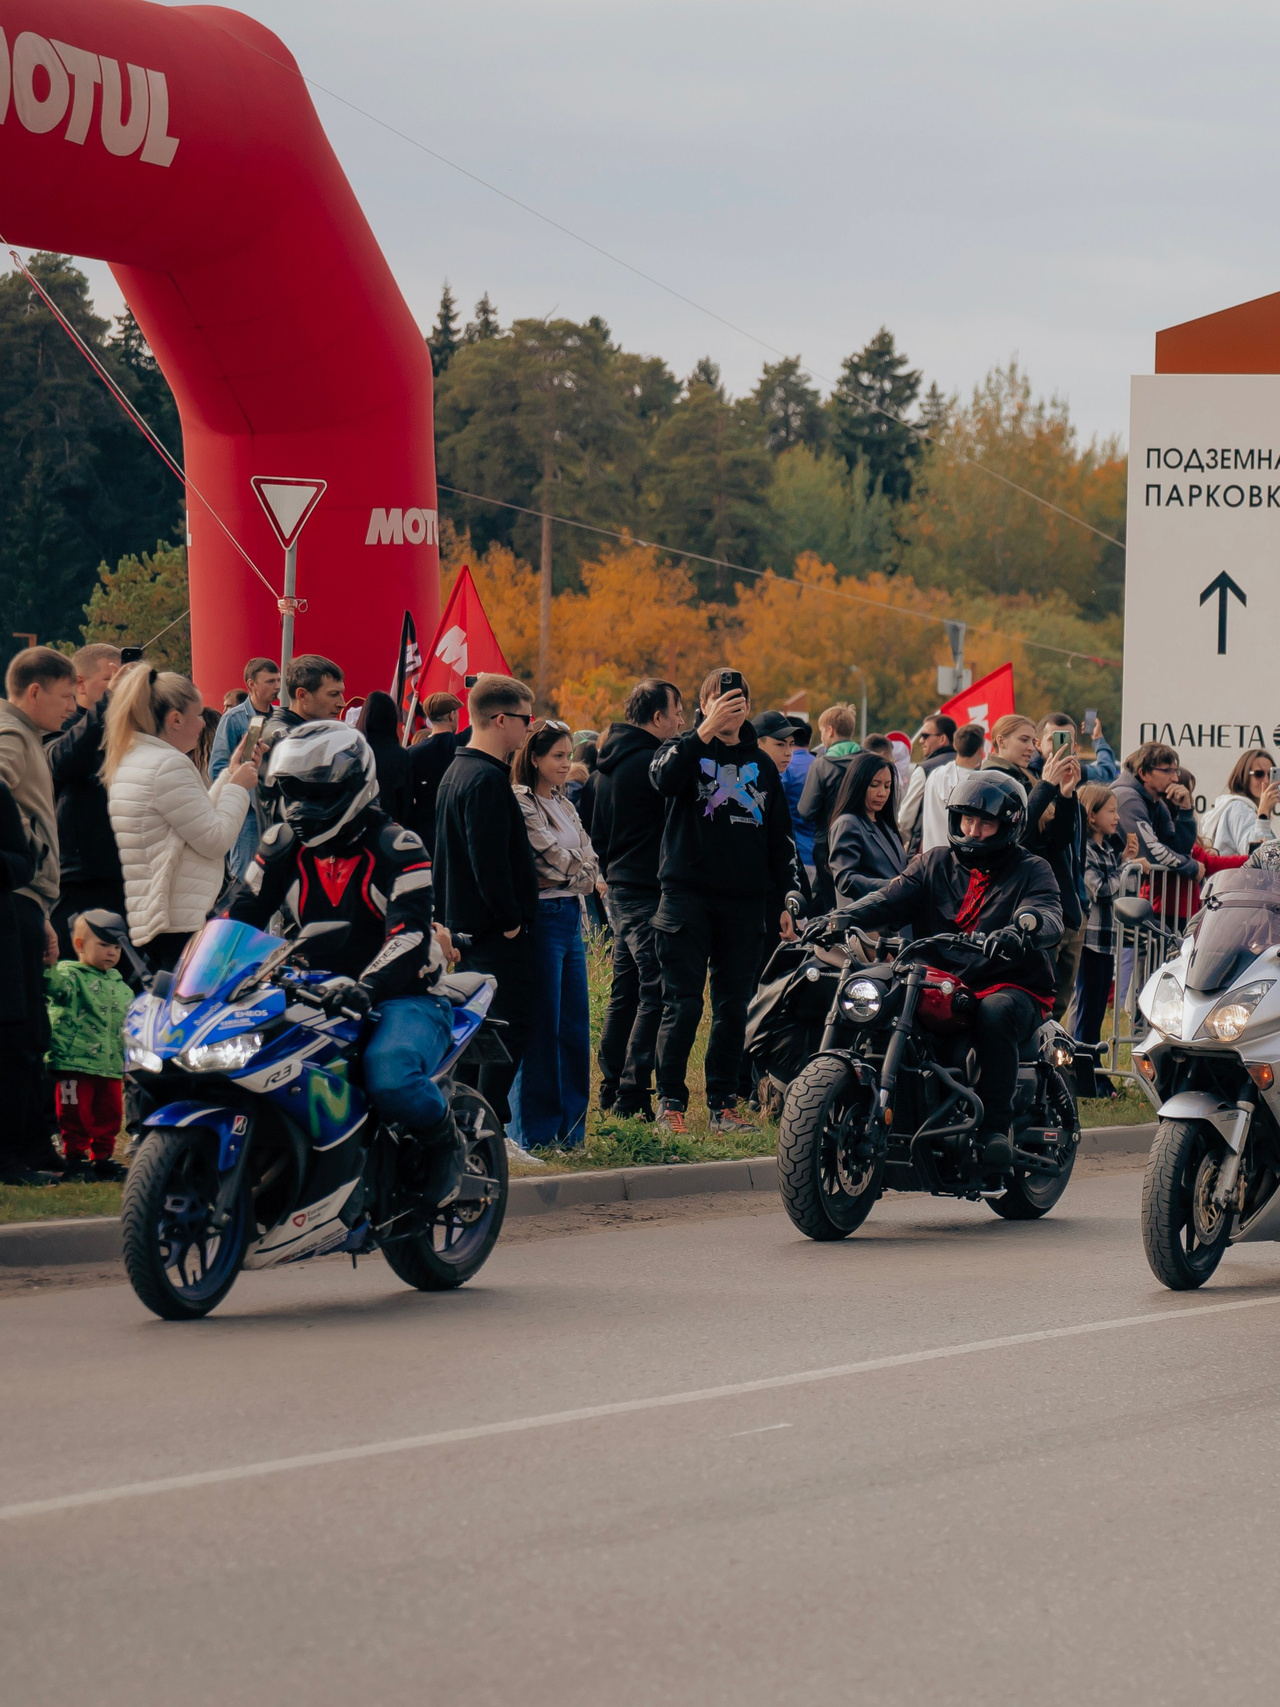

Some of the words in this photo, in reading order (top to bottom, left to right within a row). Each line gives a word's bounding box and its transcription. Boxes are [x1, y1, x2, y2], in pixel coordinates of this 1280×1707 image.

[0, 26, 180, 168] OTUL
[1140, 722, 1266, 749] ПЛАНЕТА
[1146, 841, 1182, 868] NIKE
[234, 1009, 269, 1019] ENEOS
[263, 1064, 293, 1089] R3
[60, 1079, 78, 1105] H
